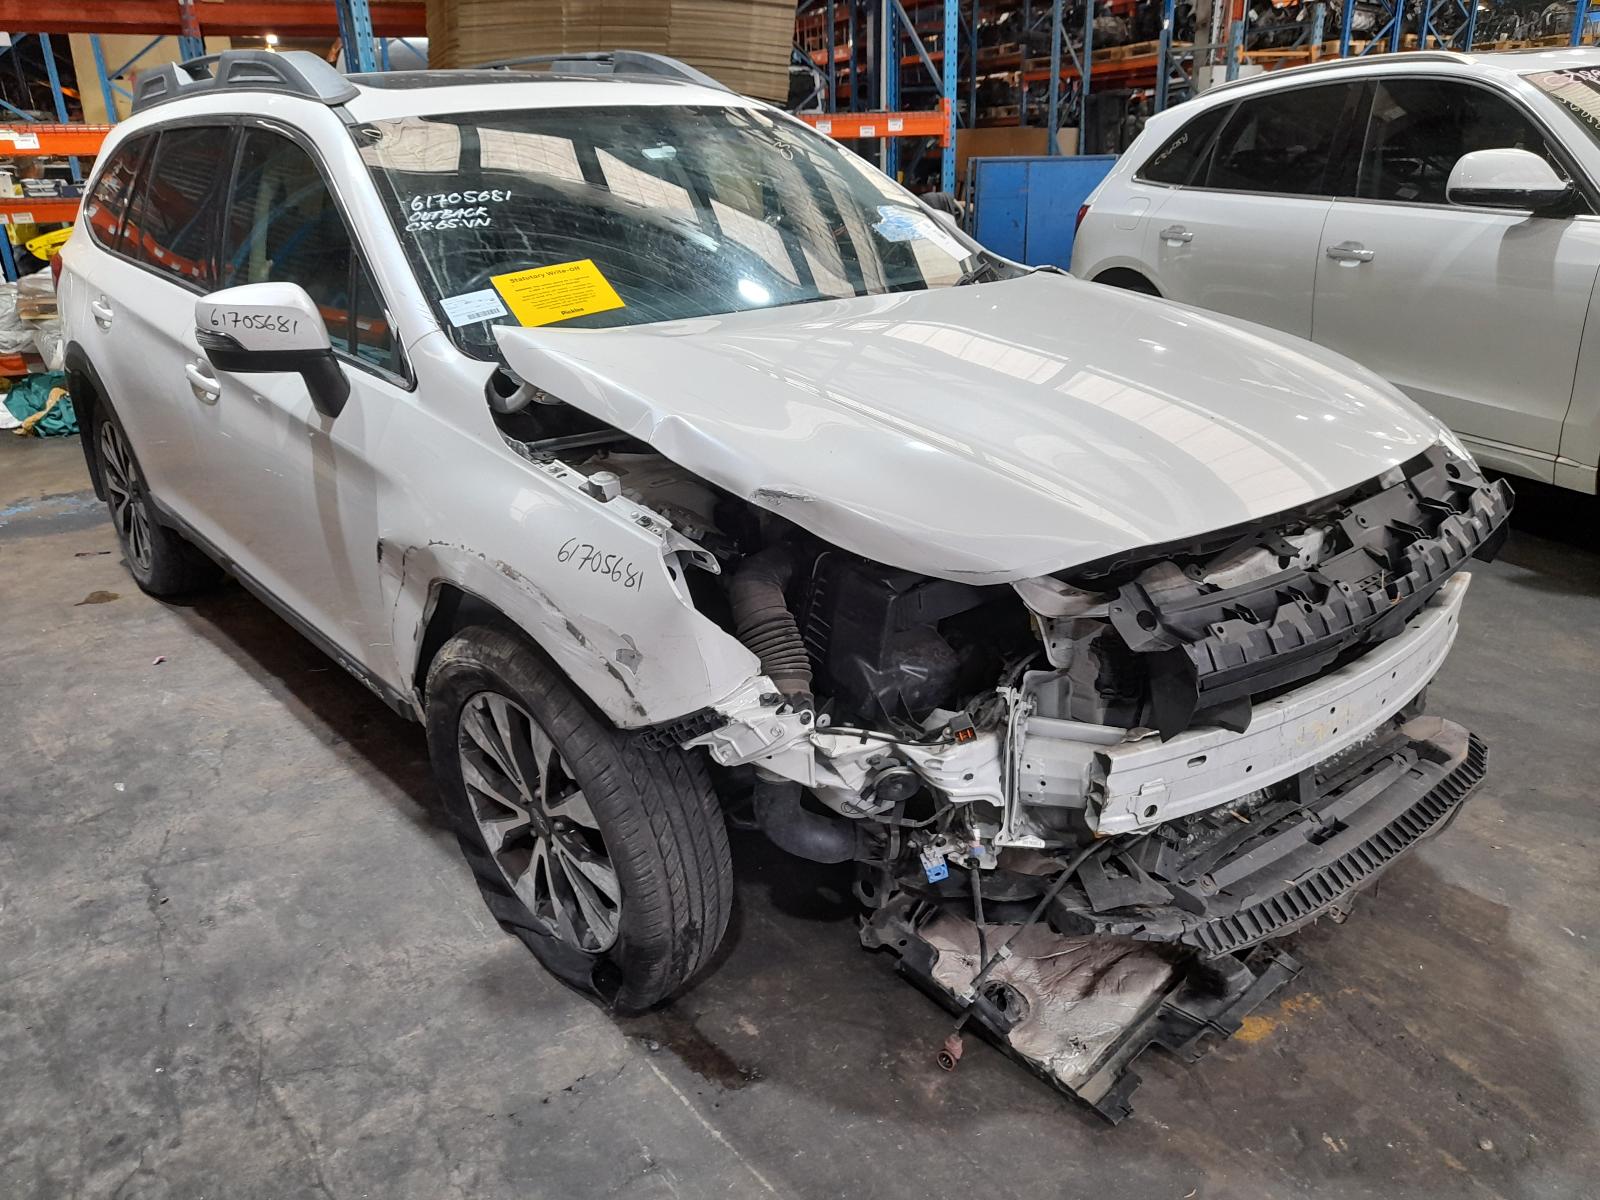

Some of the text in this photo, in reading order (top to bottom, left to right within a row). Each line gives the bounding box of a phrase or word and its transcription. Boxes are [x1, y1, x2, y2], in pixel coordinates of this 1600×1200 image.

[411, 190, 511, 211] 61705681
[410, 206, 488, 222] OUTBACK
[509, 265, 581, 284] Statutory Write-Off
[210, 308, 298, 335] 61705681
[560, 307, 585, 316] Pickles
[557, 537, 644, 592] 61705681
